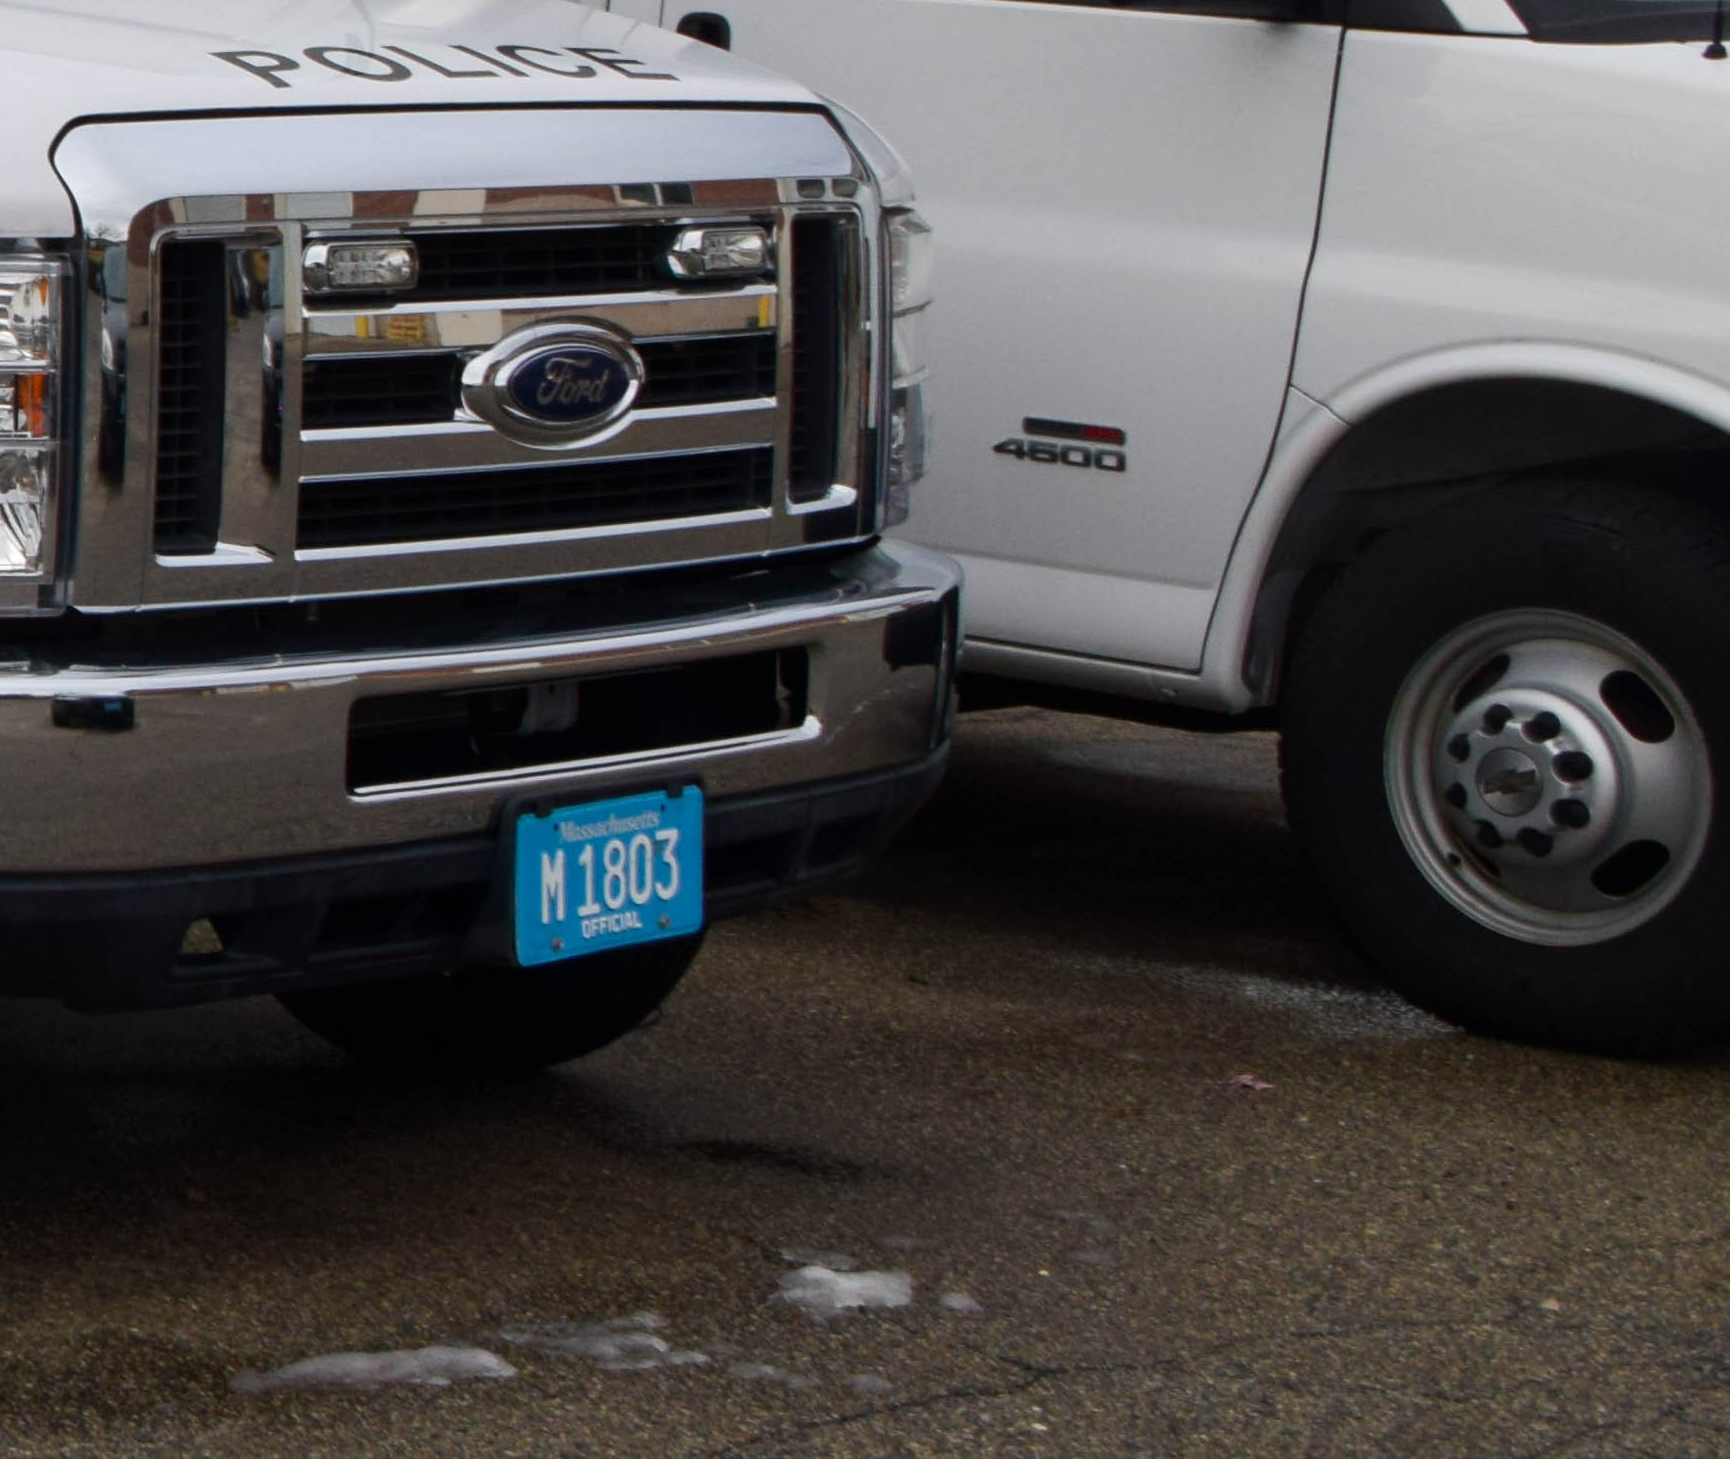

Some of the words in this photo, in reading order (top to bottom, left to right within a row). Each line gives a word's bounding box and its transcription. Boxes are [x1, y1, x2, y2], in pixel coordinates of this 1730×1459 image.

[208, 44, 682, 89] POLICE
[536, 357, 610, 405] Ford
[541, 849, 565, 924] M
[577, 828, 680, 917] 1803
[581, 911, 643, 939] OFFICIAL
